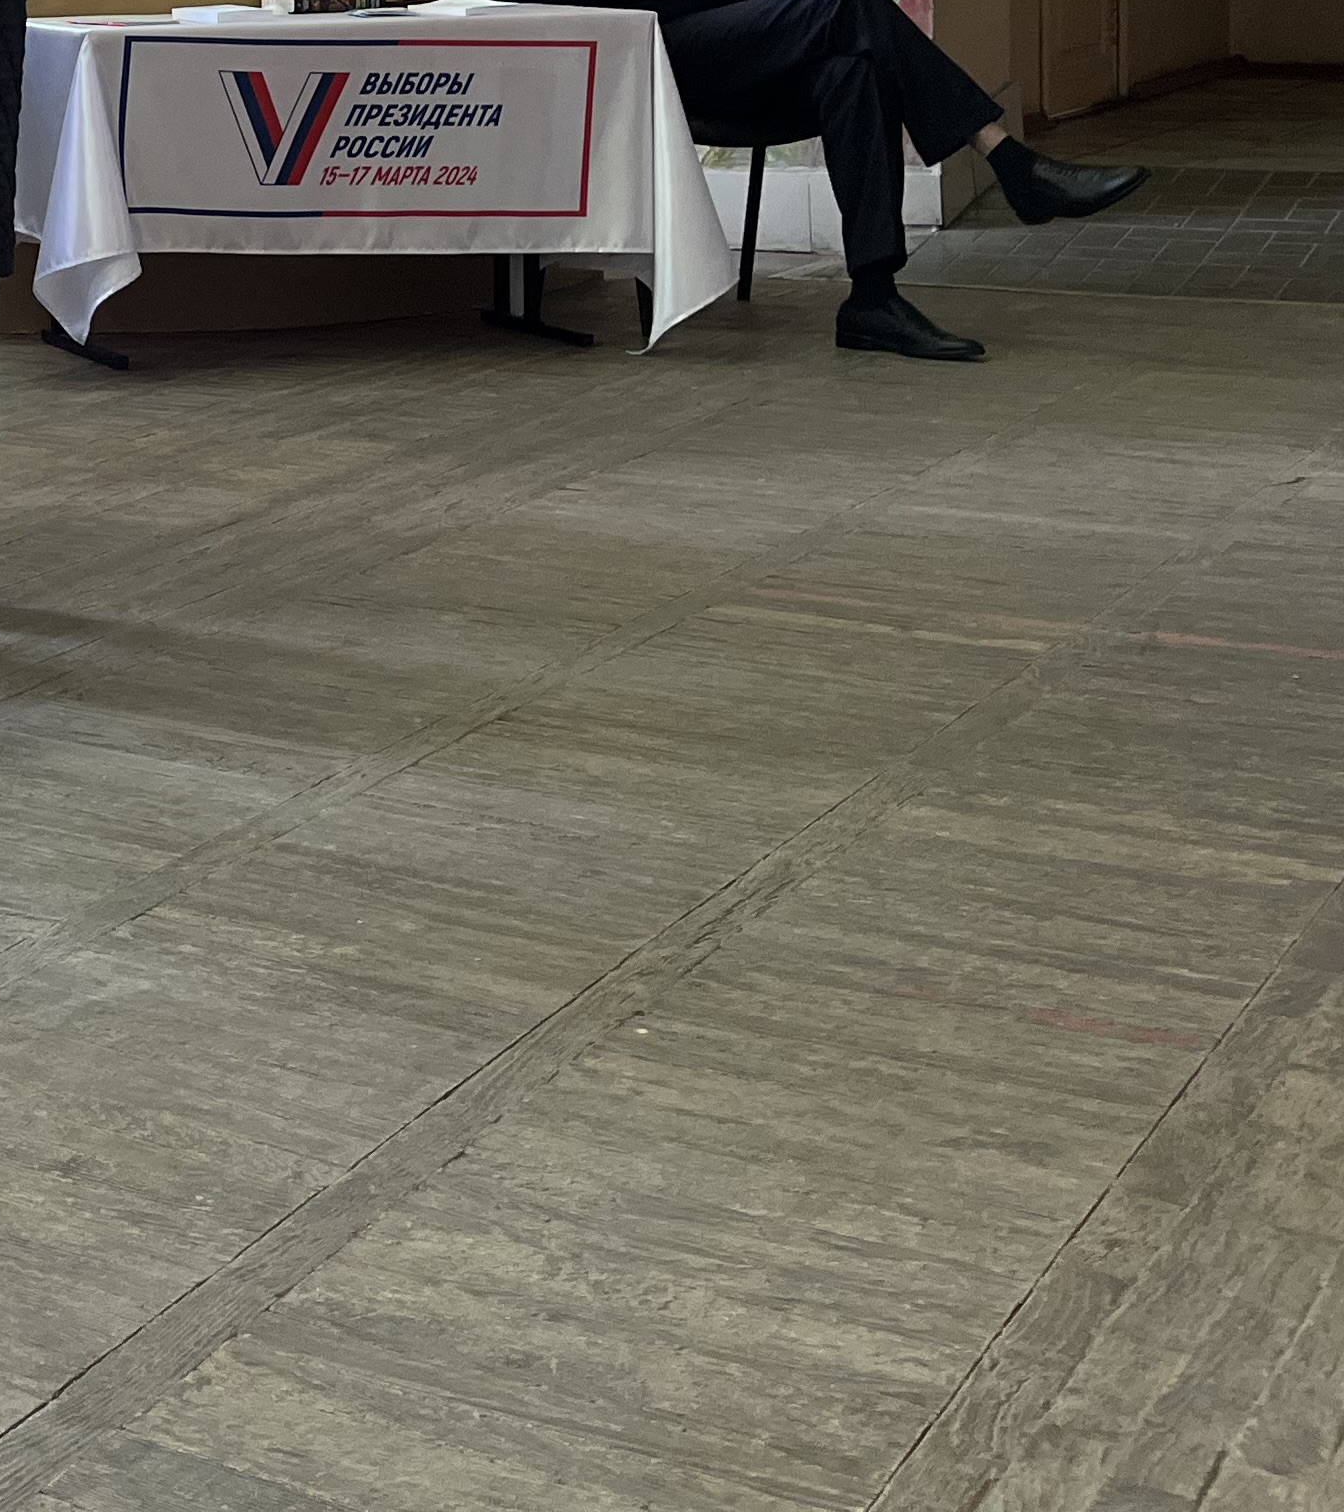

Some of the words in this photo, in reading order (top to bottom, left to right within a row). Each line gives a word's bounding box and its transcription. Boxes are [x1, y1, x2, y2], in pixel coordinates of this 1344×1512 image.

[359, 72, 475, 96] ВЫБОРЫ
[344, 104, 503, 130] ПРЕЗИДЕНТА
[329, 135, 434, 159] РОССИИ
[370, 166, 432, 186] МАРТА
[433, 165, 478, 186] 2024
